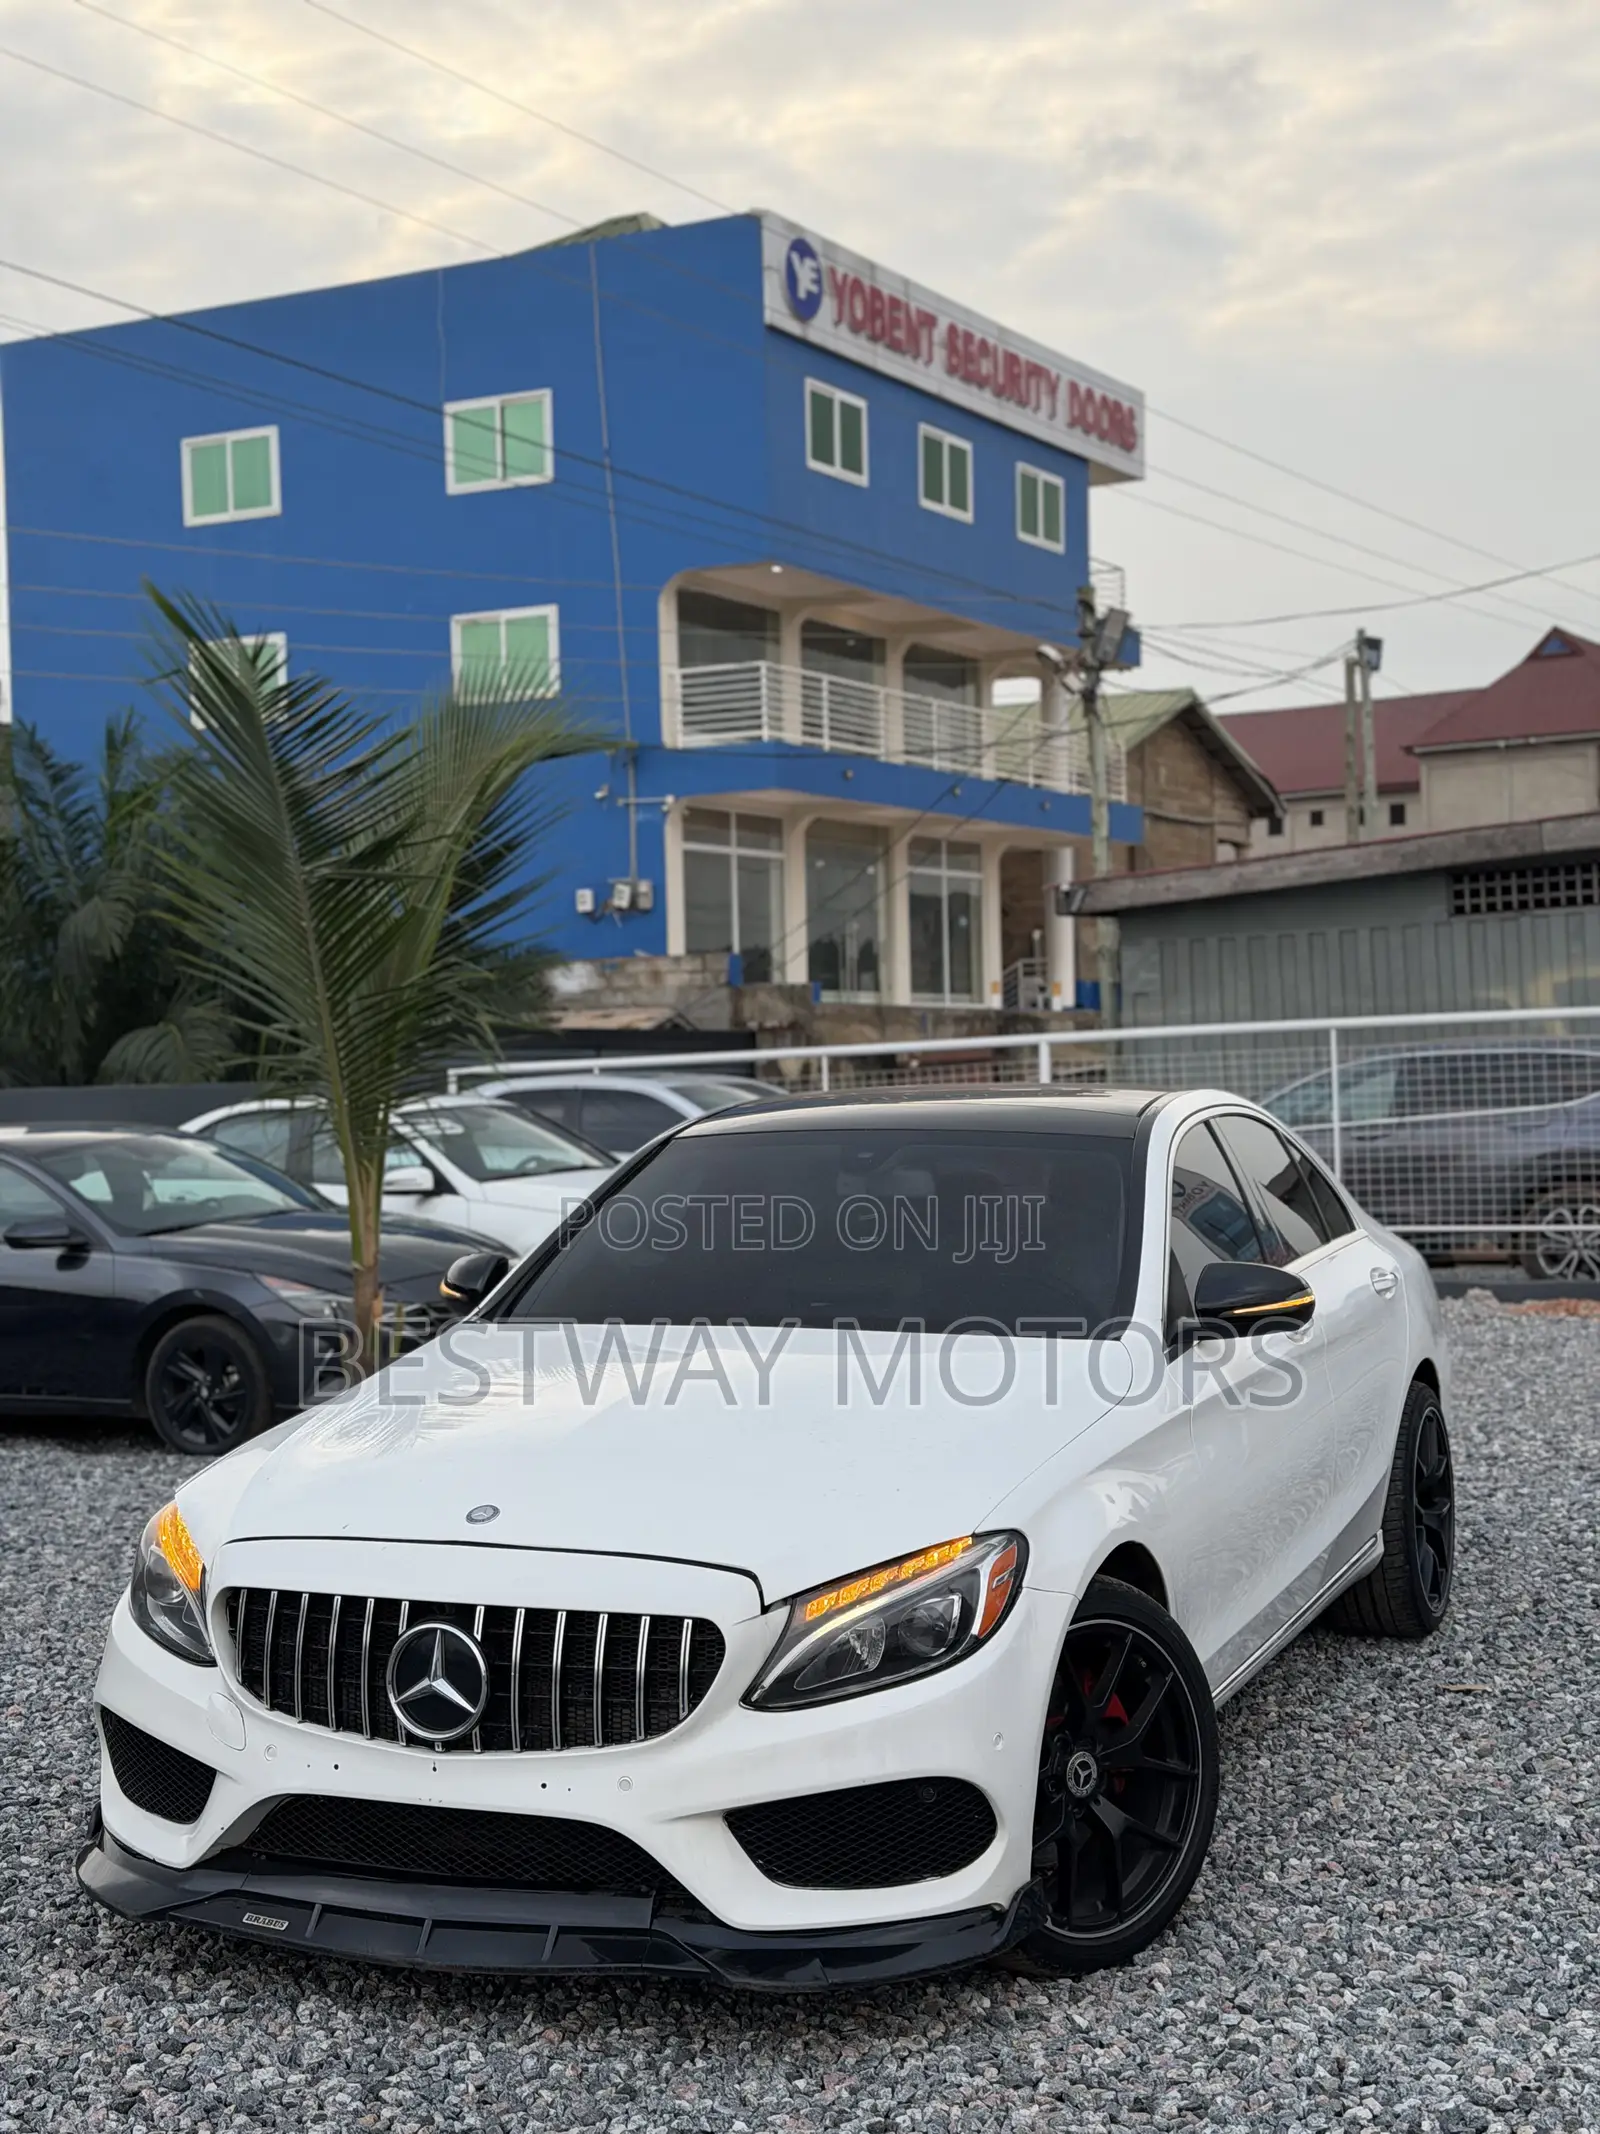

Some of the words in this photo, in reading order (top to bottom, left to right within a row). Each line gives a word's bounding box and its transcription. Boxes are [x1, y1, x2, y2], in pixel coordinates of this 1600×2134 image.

[829, 264, 938, 367] YOBENT
[945, 321, 1060, 421] SECURITY
[1067, 379, 1137, 453] DOORS
[245, 1914, 286, 1929] BRABUS
